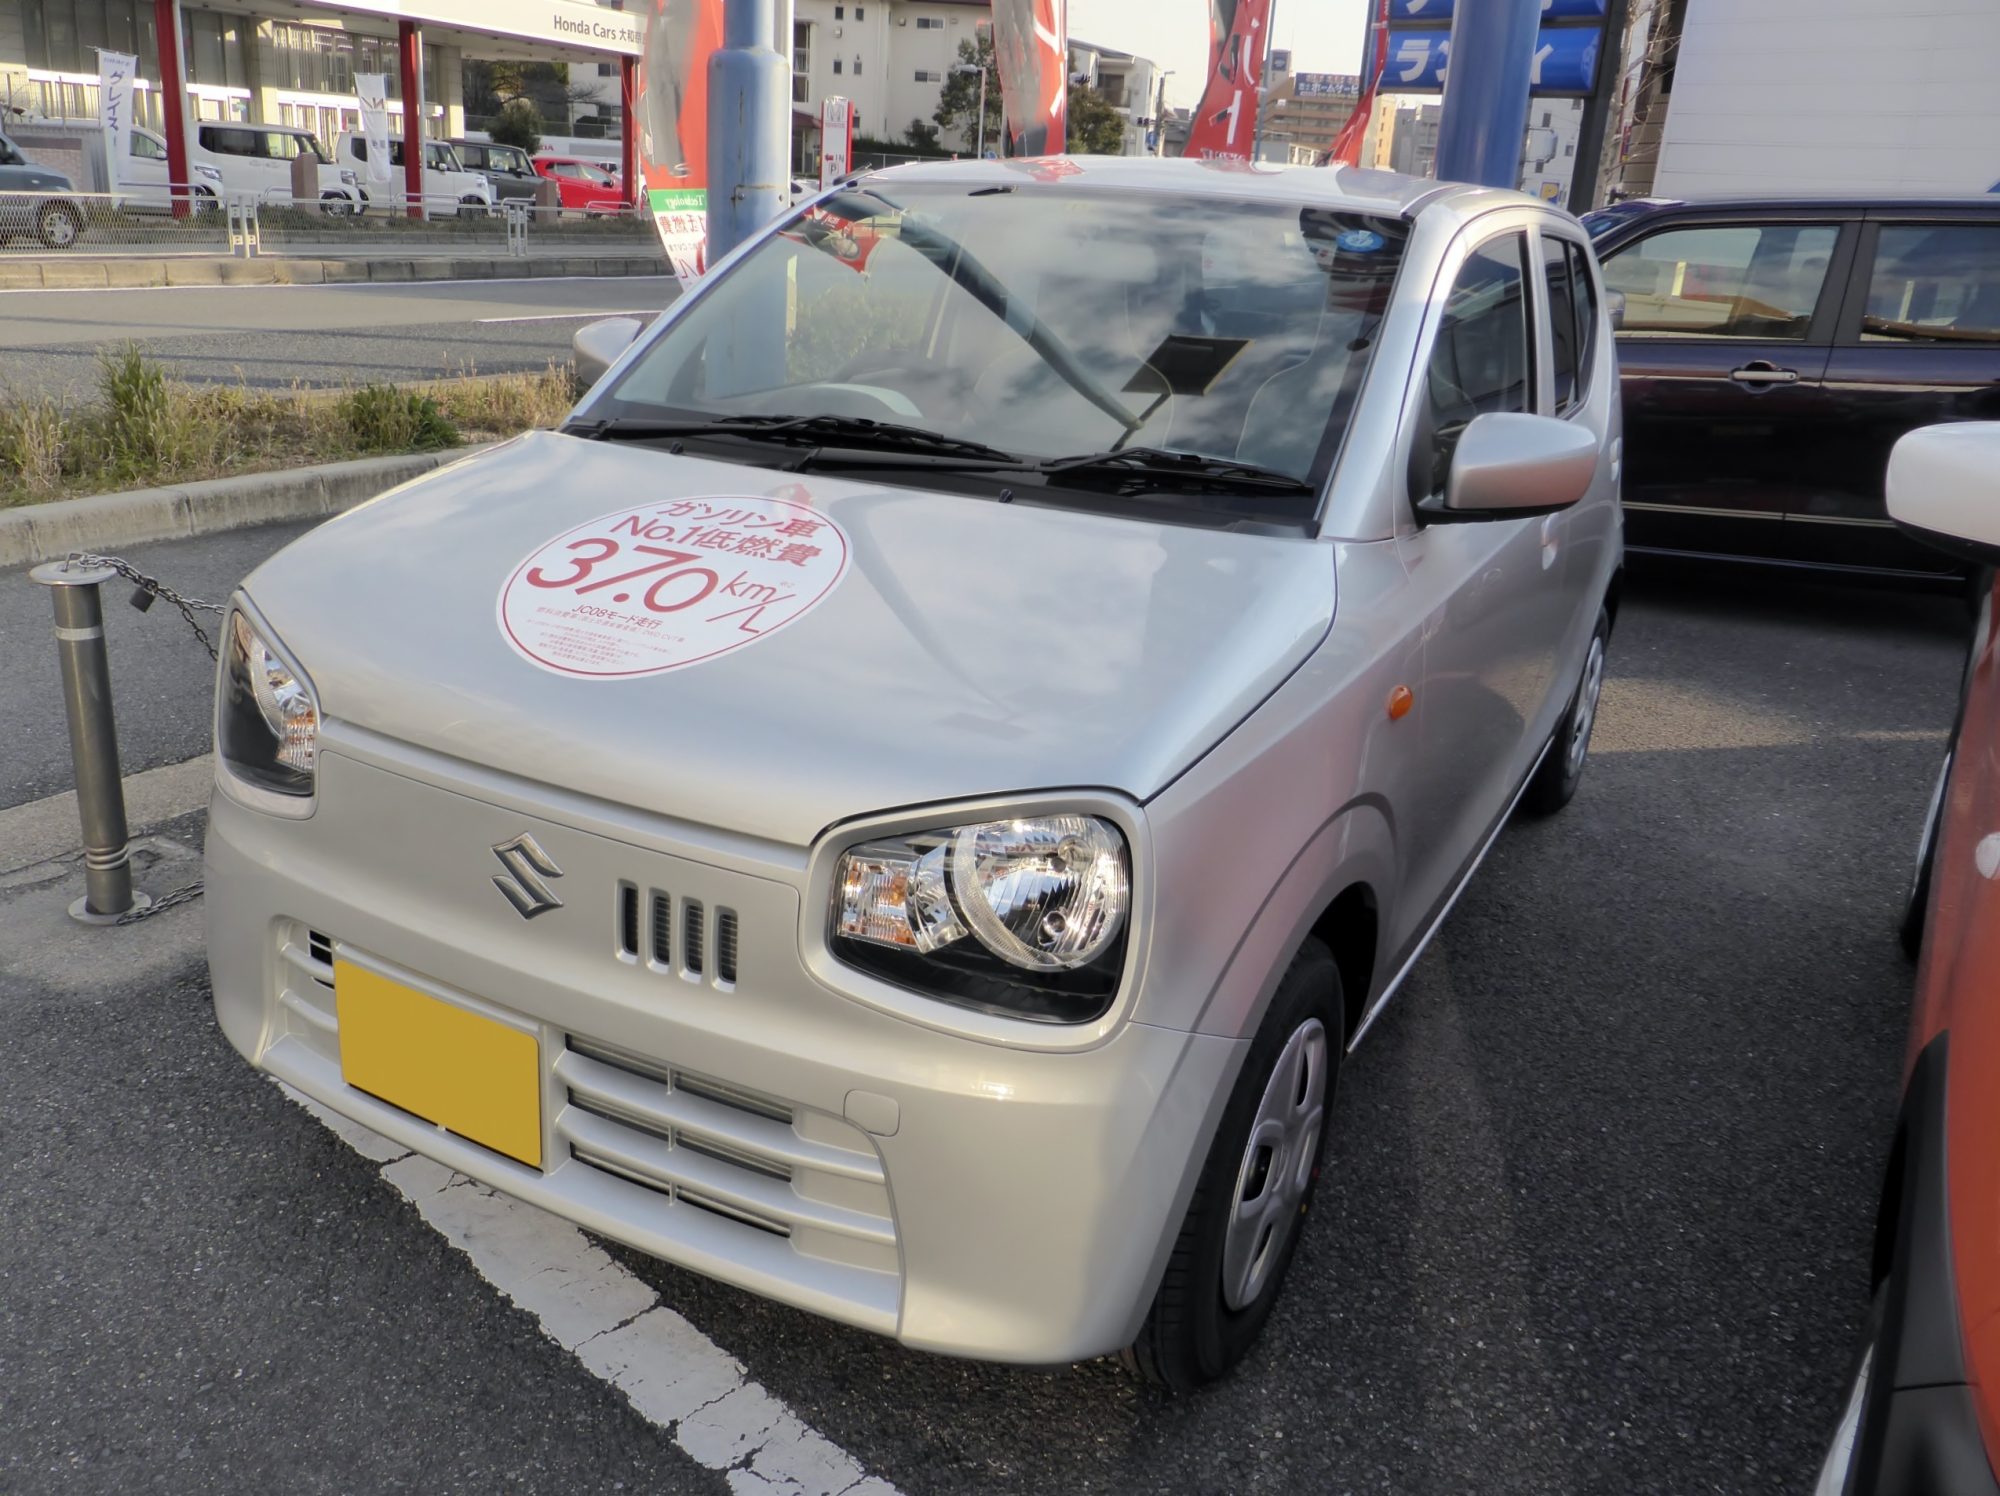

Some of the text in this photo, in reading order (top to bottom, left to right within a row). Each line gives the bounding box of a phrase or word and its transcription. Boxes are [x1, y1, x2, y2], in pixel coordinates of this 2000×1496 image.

[553, 14, 591, 36] Honda
[593, 22, 617, 41] Cars
[107, 70, 125, 132] グレイス
[609, 515, 823, 567] No.1低燃費
[655, 501, 828, 538] ガソリン車
[525, 537, 720, 613] 37.0
[571, 603, 664, 631] JC08モード走行
